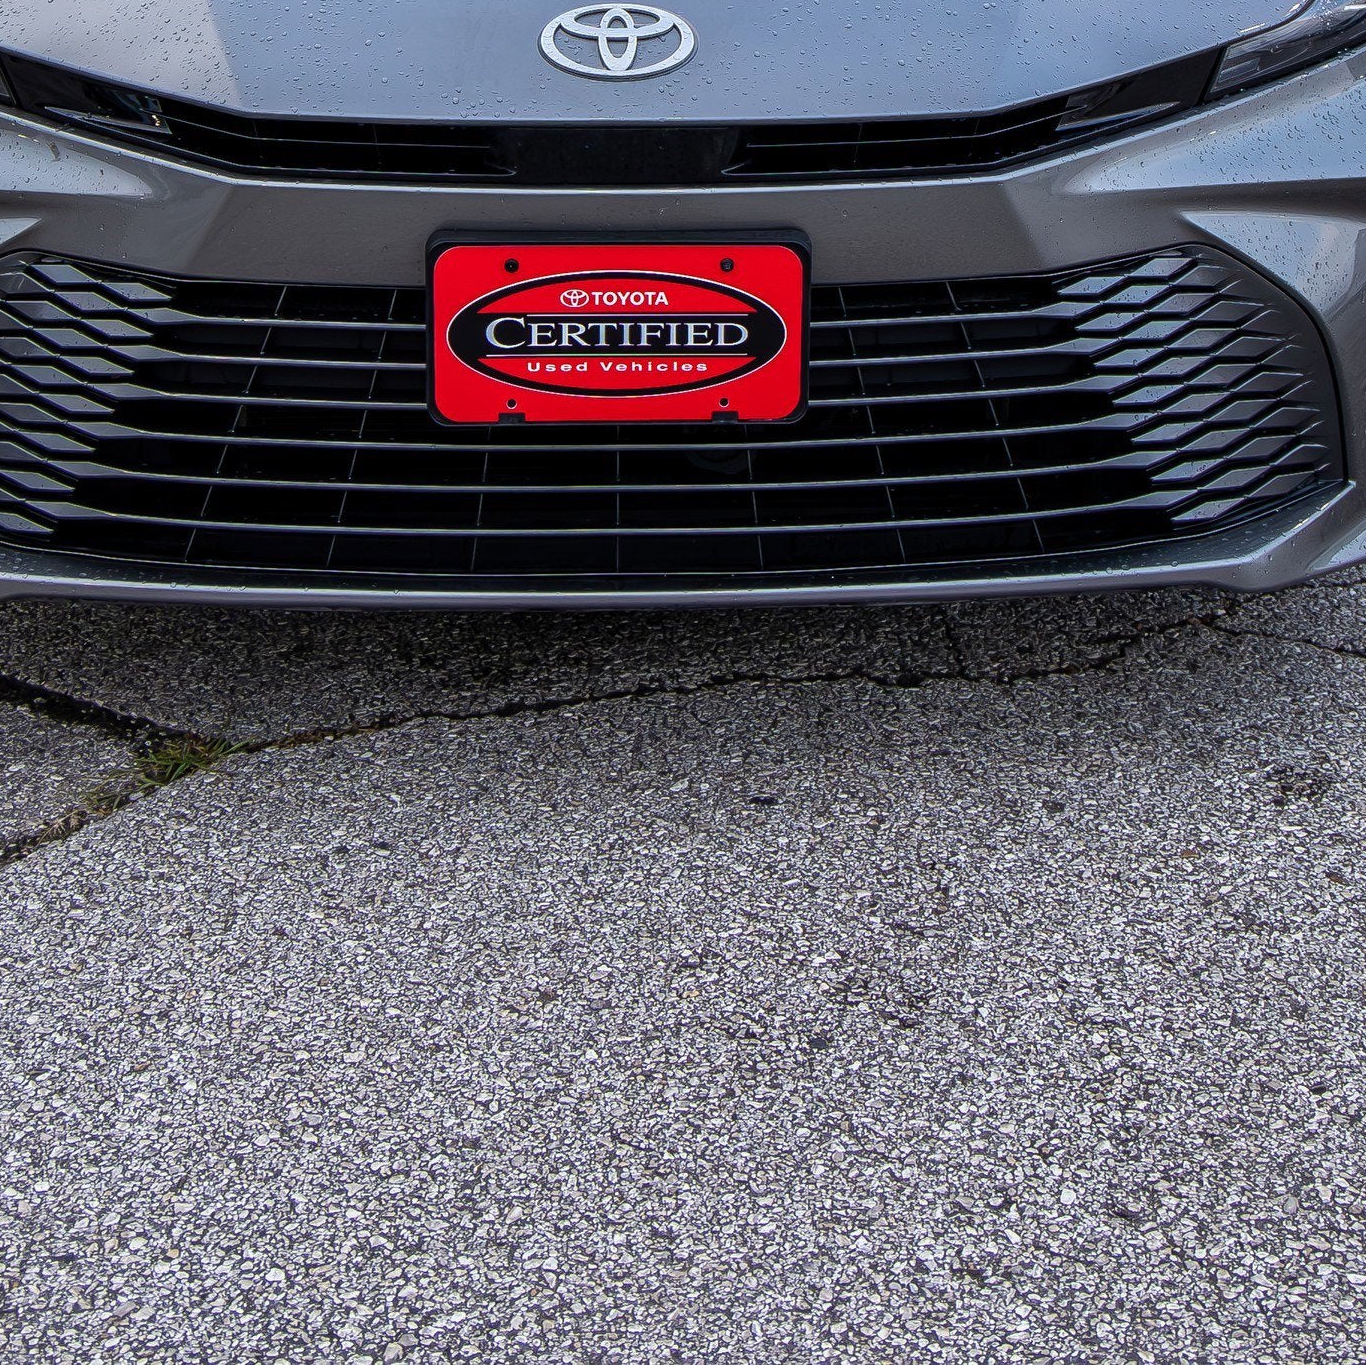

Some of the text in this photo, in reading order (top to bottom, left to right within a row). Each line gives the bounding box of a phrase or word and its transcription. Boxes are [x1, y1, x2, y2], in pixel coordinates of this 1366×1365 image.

[592, 291, 668, 306] TOYOTA
[485, 317, 749, 349] CERTIFIED
[527, 361, 708, 372] Used Vehicles
